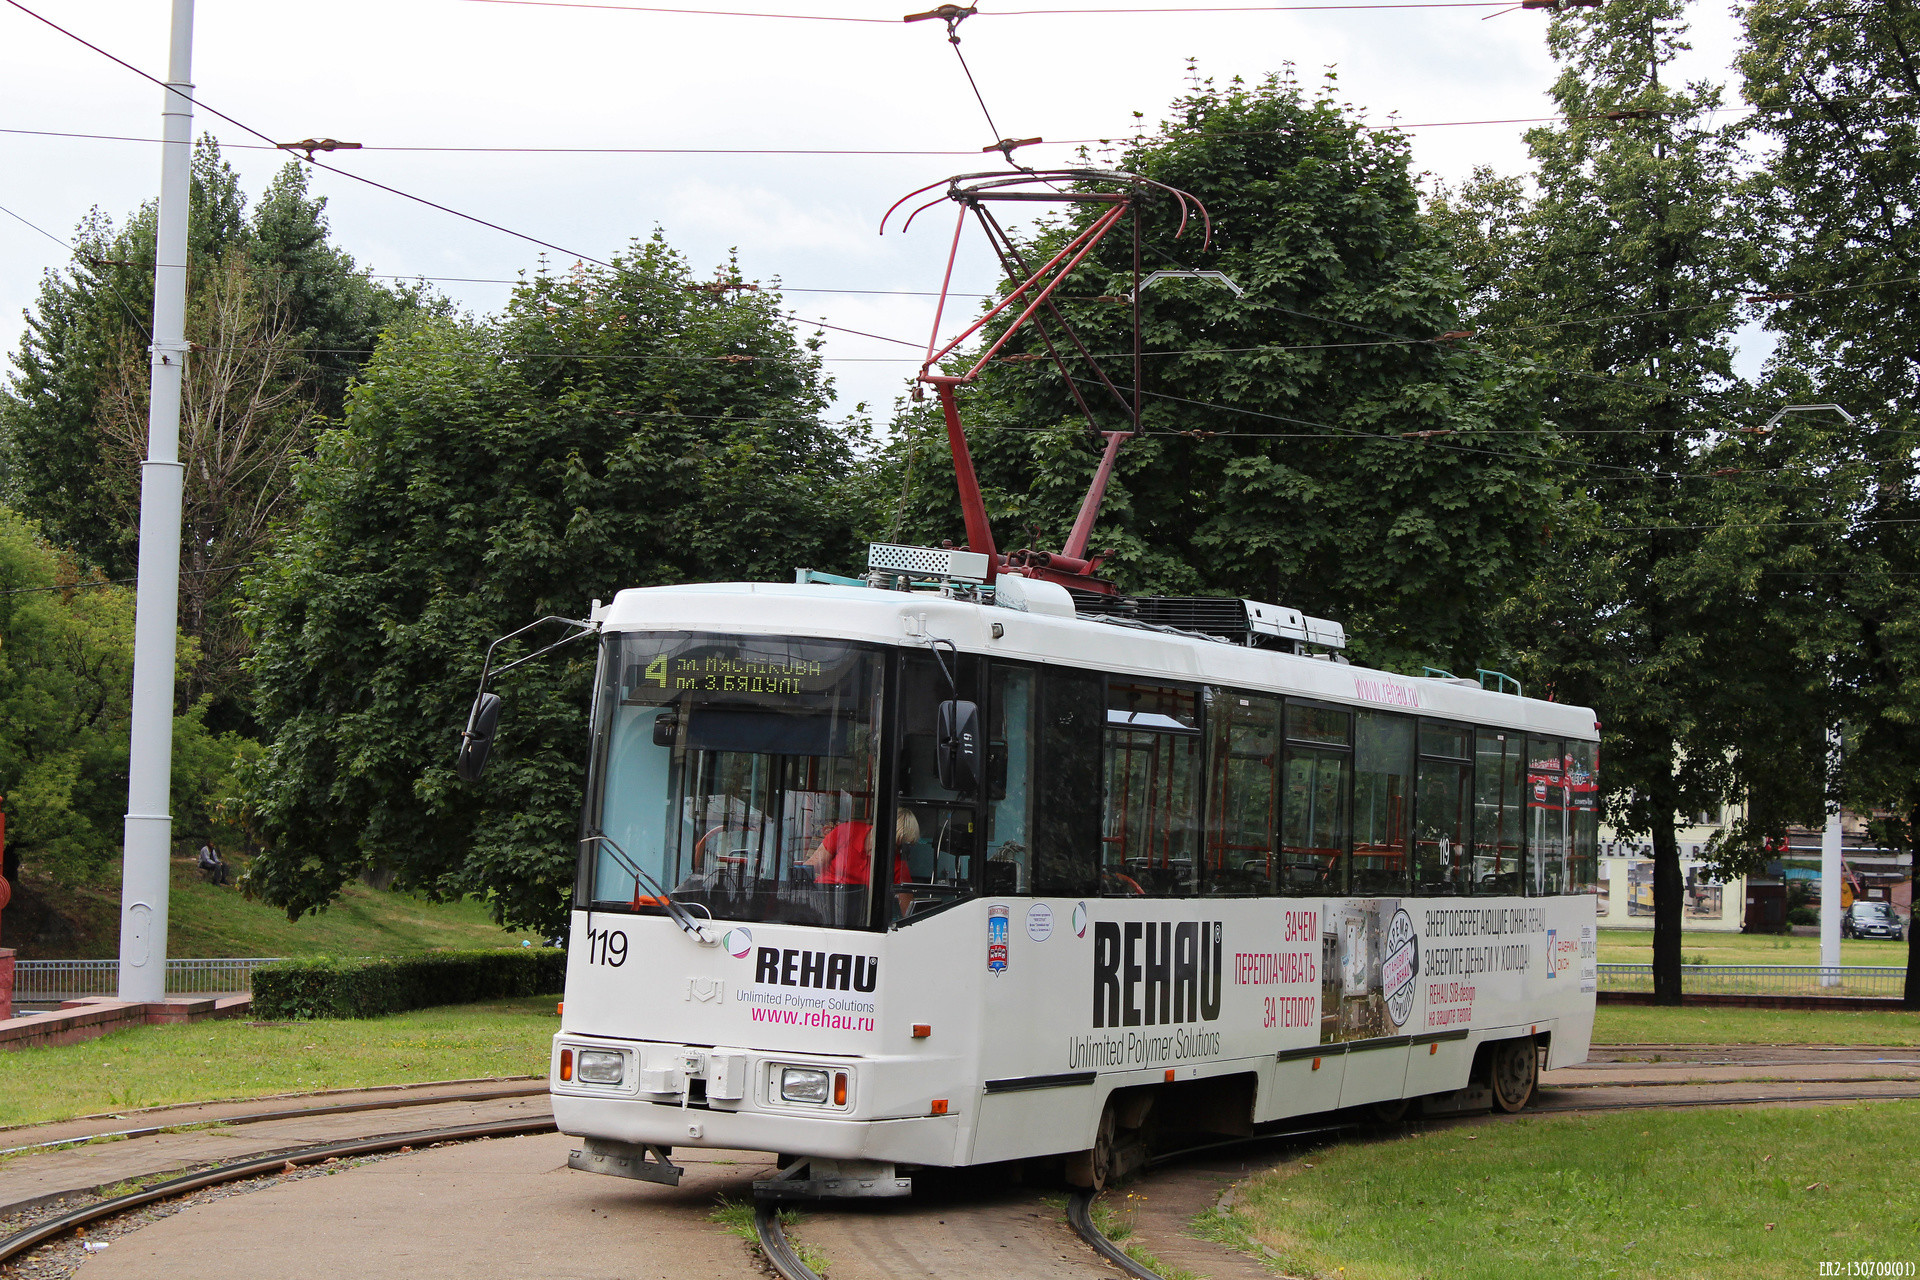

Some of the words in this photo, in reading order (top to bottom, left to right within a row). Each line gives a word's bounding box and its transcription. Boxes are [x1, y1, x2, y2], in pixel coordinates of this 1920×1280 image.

[645, 654, 667, 688] 4
[1354, 677, 1418, 707] www.rehau.ru
[963, 733, 973, 754] 119
[1439, 838, 1450, 866] 119
[1284, 910, 1317, 942] ЗАЧЕМ
[1388, 917, 1409, 954] ВРЕМЯ
[1425, 909, 1508, 940] ЭНЕРГОСБЕРЕГАЮЩИЕ
[1509, 908, 1527, 934] ОКНА
[1529, 907, 1546, 933] REHAU
[587, 928, 628, 968] 119
[1425, 948, 1463, 977] ЗАБЕРИТЕ
[1465, 946, 1493, 979] ДЕНЬГИ
[1495, 945, 1500, 972] У
[1501, 944, 1530, 975] ХОЛОДА!
[1234, 953, 1316, 985] ПЕРЕПЛАЧИВАТЬ
[736, 989, 782, 1005] Unlimited
[785, 993, 825, 1009] Polymer
[828, 998, 875, 1013] Solutions
[1429, 983, 1449, 1005] REHAU
[752, 1008, 874, 1031] www.rehau.ru
[1264, 996, 1276, 1028] ЗА
[1280, 996, 1315, 1028] ТЕПЛО?
[1428, 1011, 1435, 1026] на
[1069, 1033, 1124, 1069] Unlimited
[1128, 1031, 1174, 1069] Polymer
[1176, 1027, 1220, 1059] Solutions
